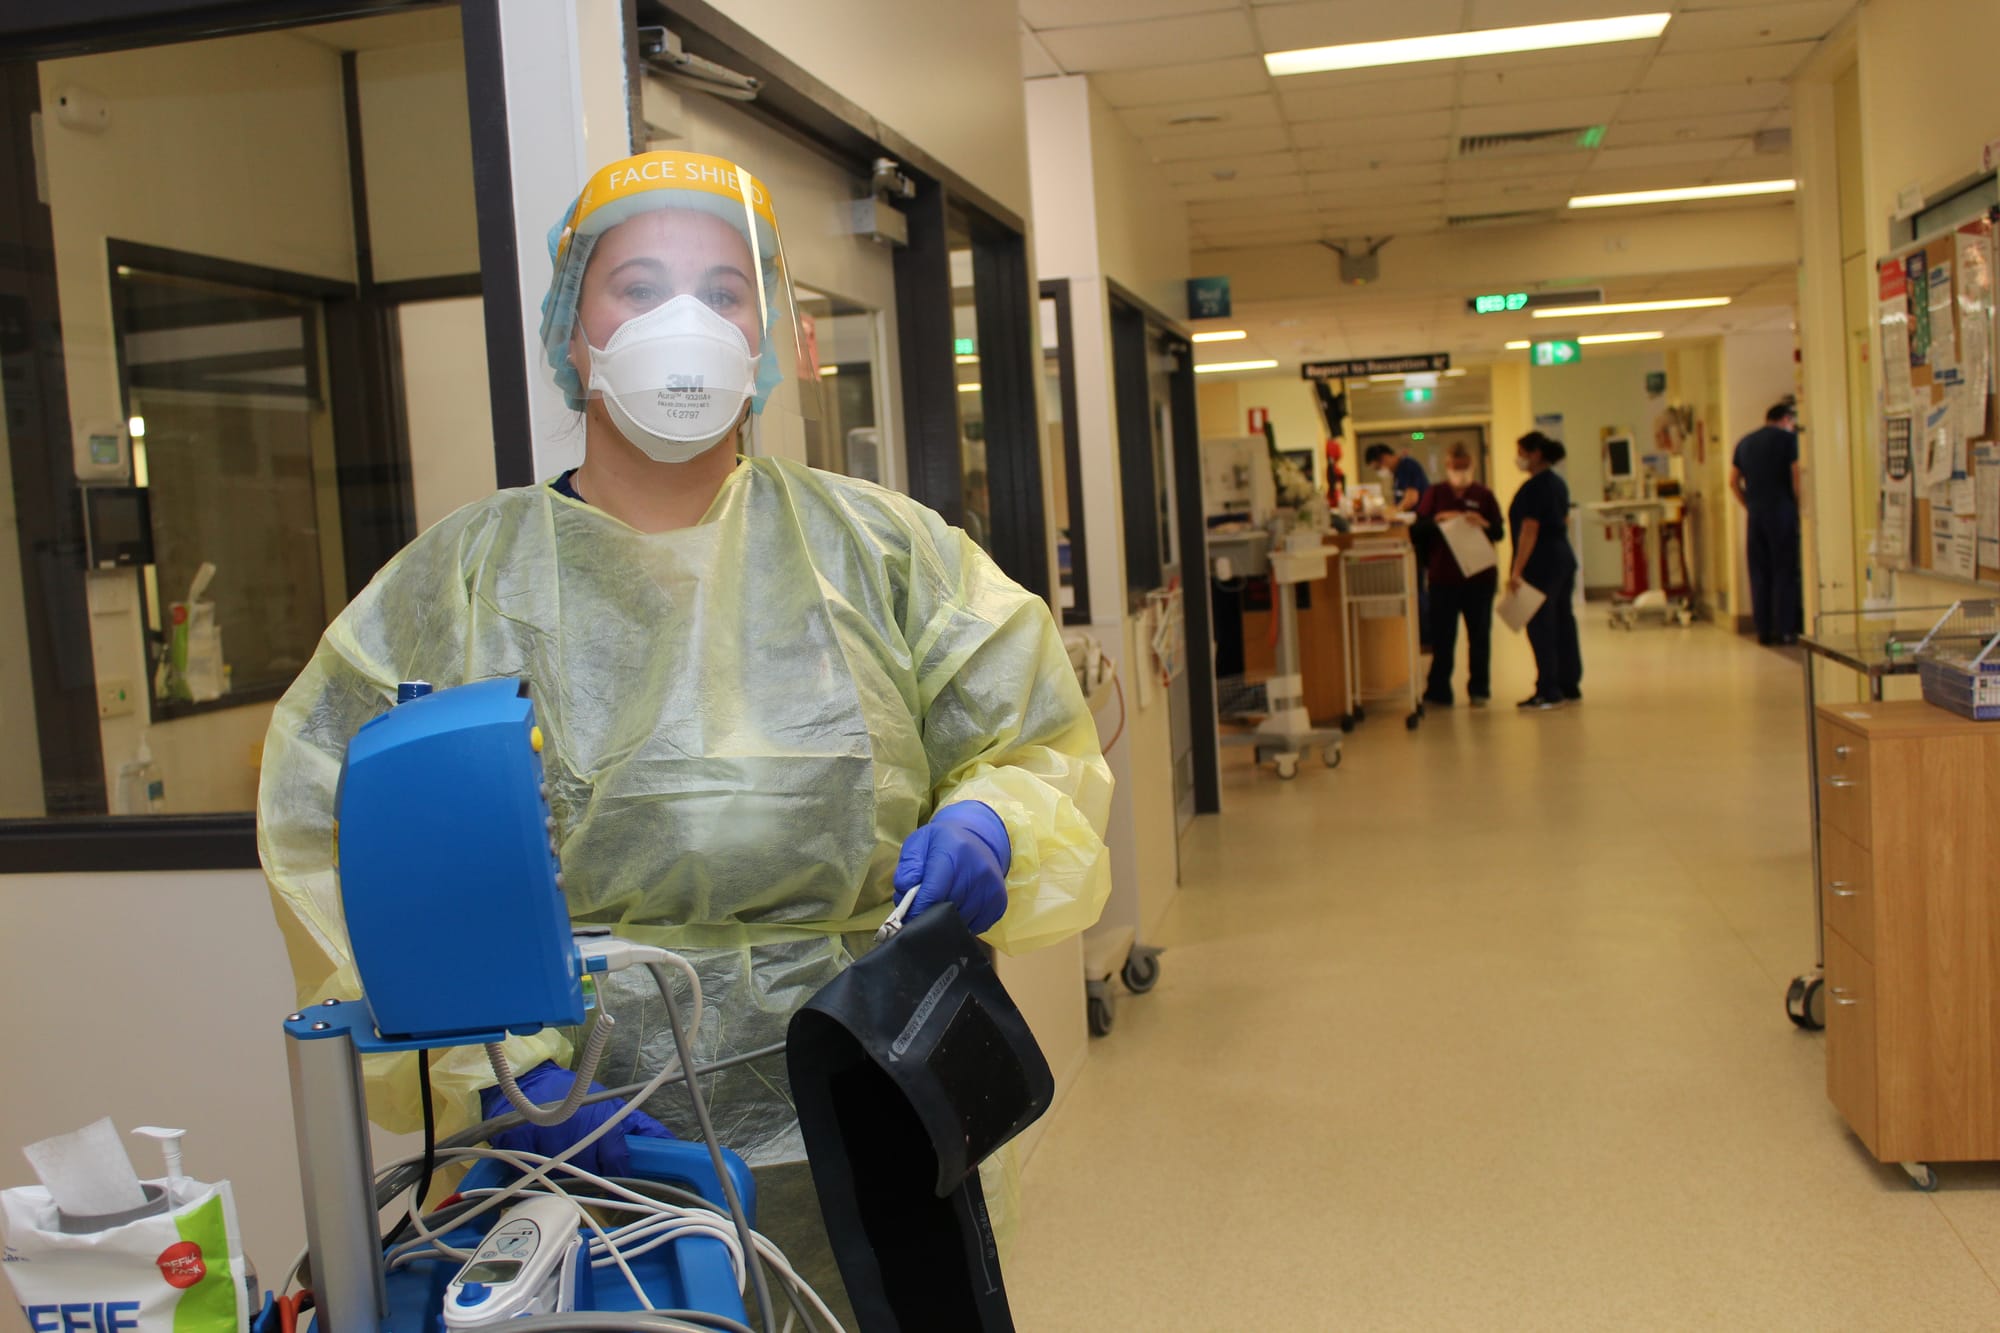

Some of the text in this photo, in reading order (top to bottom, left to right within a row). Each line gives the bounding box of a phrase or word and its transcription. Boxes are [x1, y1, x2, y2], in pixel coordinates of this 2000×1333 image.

[609, 161, 764, 205] FACE SHIED
[666, 374, 704, 392] 3M
